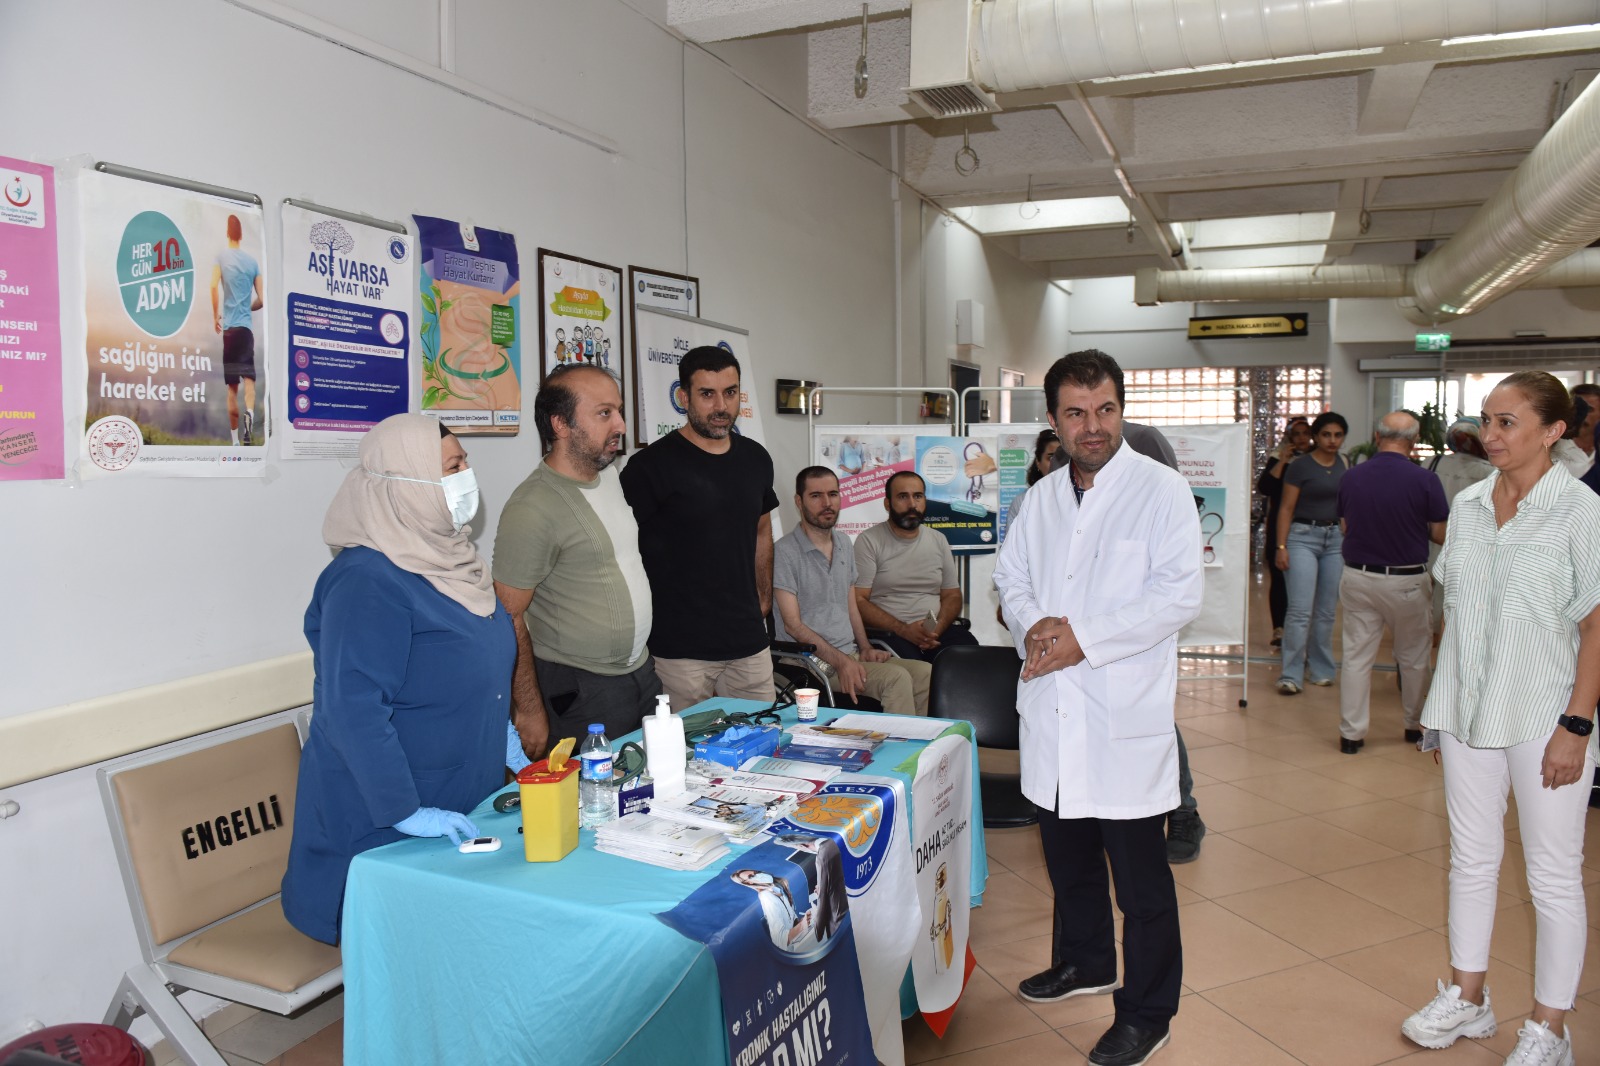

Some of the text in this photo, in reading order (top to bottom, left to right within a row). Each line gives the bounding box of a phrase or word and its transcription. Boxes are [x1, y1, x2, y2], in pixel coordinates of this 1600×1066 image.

[131, 242, 153, 260] HER
[153, 237, 184, 273] 10 bin
[131, 259, 152, 278] GÜN
[338, 257, 389, 287] VARSA
[443, 266, 467, 281] Hayat
[444, 252, 496, 274] Erken Teşhis
[326, 278, 359, 297] HAYAT
[673, 337, 689, 351] DİCLE
[25, 351, 47, 361] MI?
[99, 342, 212, 377] sağlığın için
[647, 347, 685, 366] ÜNİVERSİTE
[100, 372, 206, 403] hareket et!
[858, 474, 875, 484] Anne
[180, 794, 283, 860] ENGELLİ
[916, 830, 942, 875] DAHA
[855, 855, 873, 880] 1973
[735, 1026, 771, 1066] KRONİK
[771, 970, 827, 1042] HASTALIĞINIZ
[791, 997, 833, 1066] MI?
